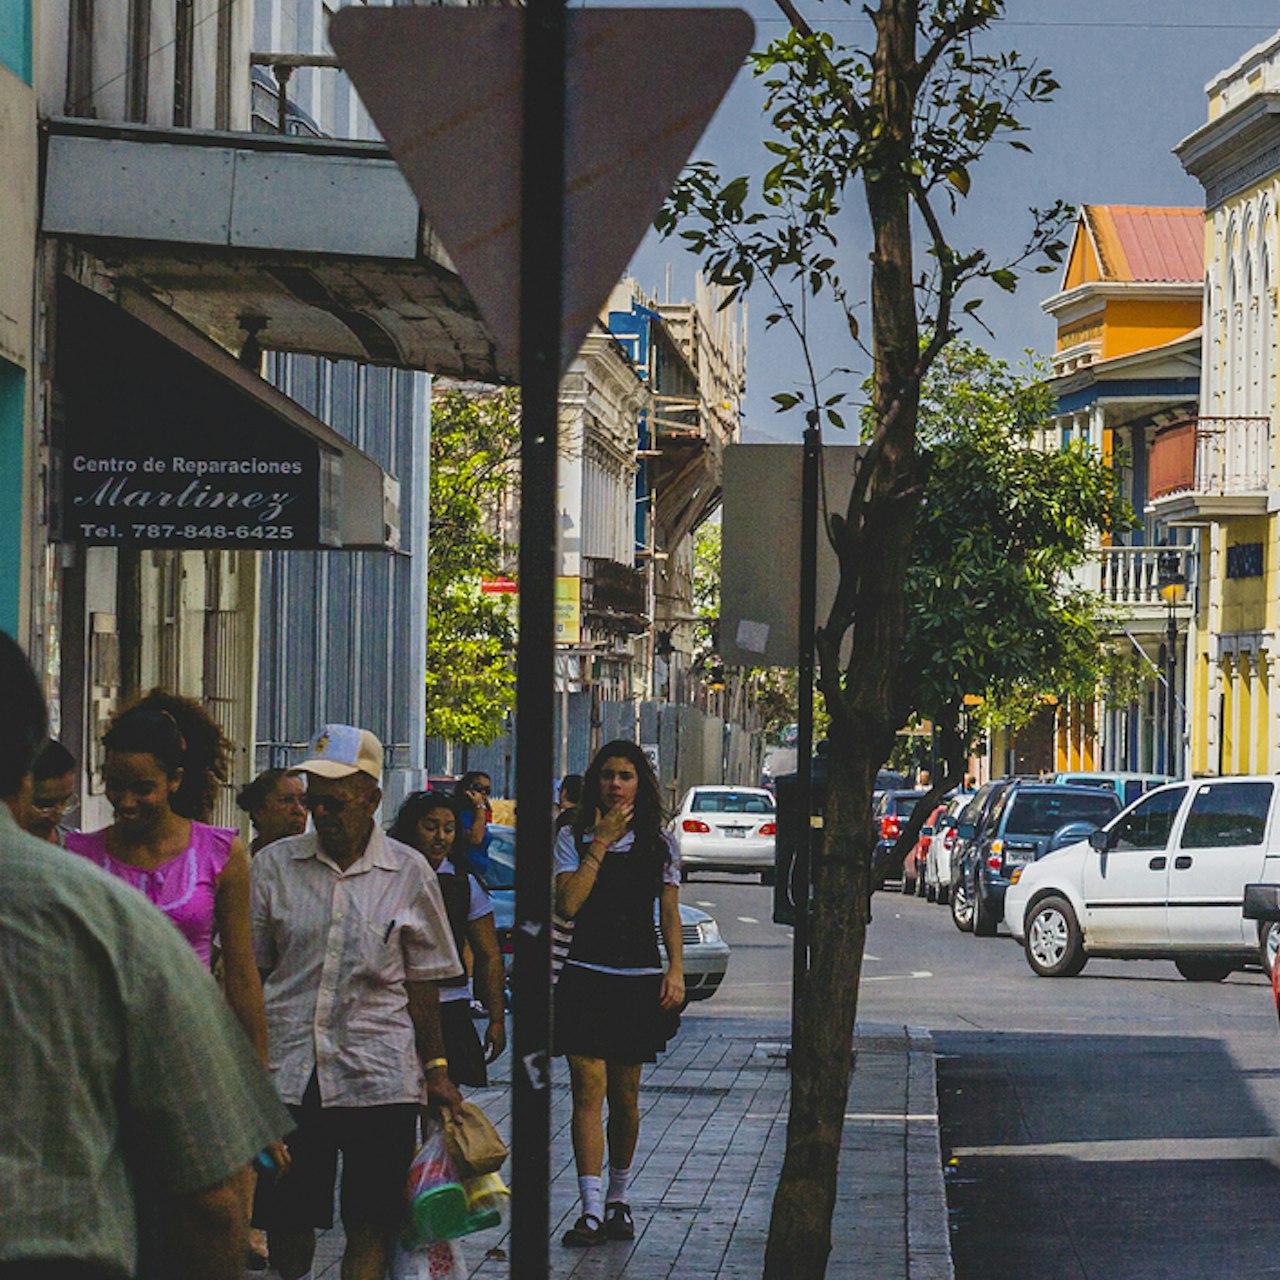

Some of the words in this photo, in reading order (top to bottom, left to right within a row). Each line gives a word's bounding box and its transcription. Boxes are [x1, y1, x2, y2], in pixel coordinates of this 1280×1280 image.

[73, 455, 137, 472] Centro
[143, 456, 166, 472] de
[172, 456, 302, 477] Reparaciones
[73, 476, 299, 522] Martinez
[80, 523, 124, 538] Tel.
[132, 524, 295, 540] 787-848-6425
